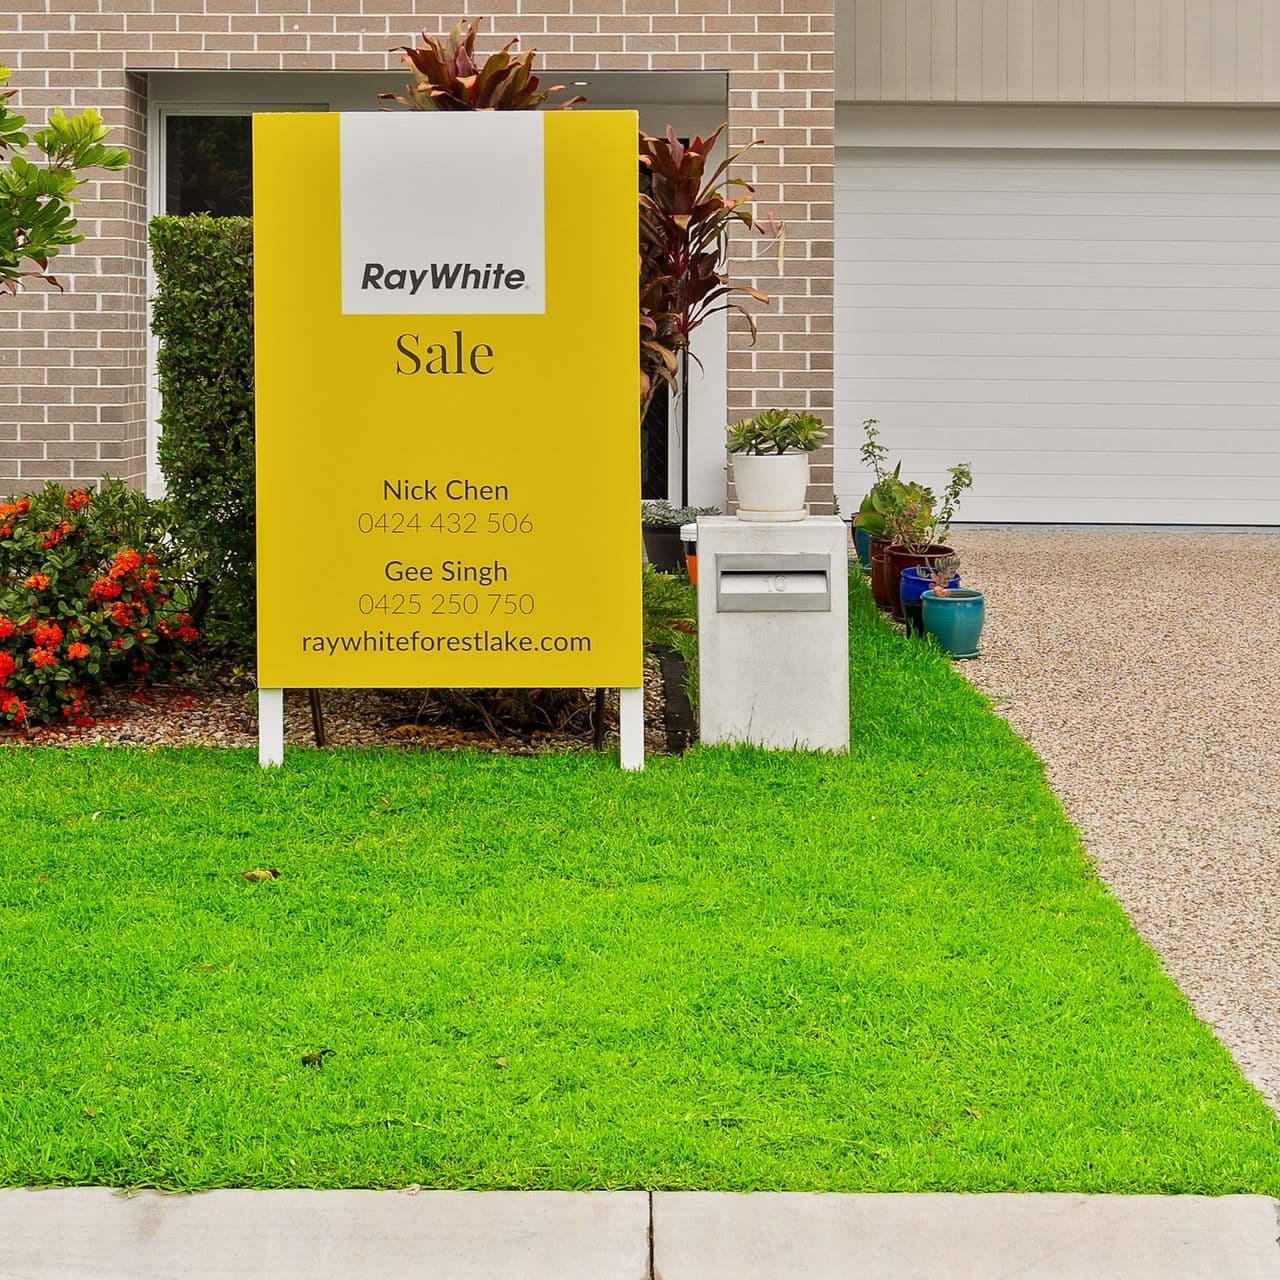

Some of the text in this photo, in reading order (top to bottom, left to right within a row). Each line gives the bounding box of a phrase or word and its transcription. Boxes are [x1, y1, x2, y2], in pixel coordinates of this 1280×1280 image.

[396, 330, 495, 375] Sale
[383, 479, 509, 501] Nick Chen
[358, 512, 534, 534] 0424 432 506
[384, 560, 508, 587] Gee Singh
[358, 593, 535, 615] 0425 250 750
[302, 630, 592, 657] raywhiteforestlake.com
